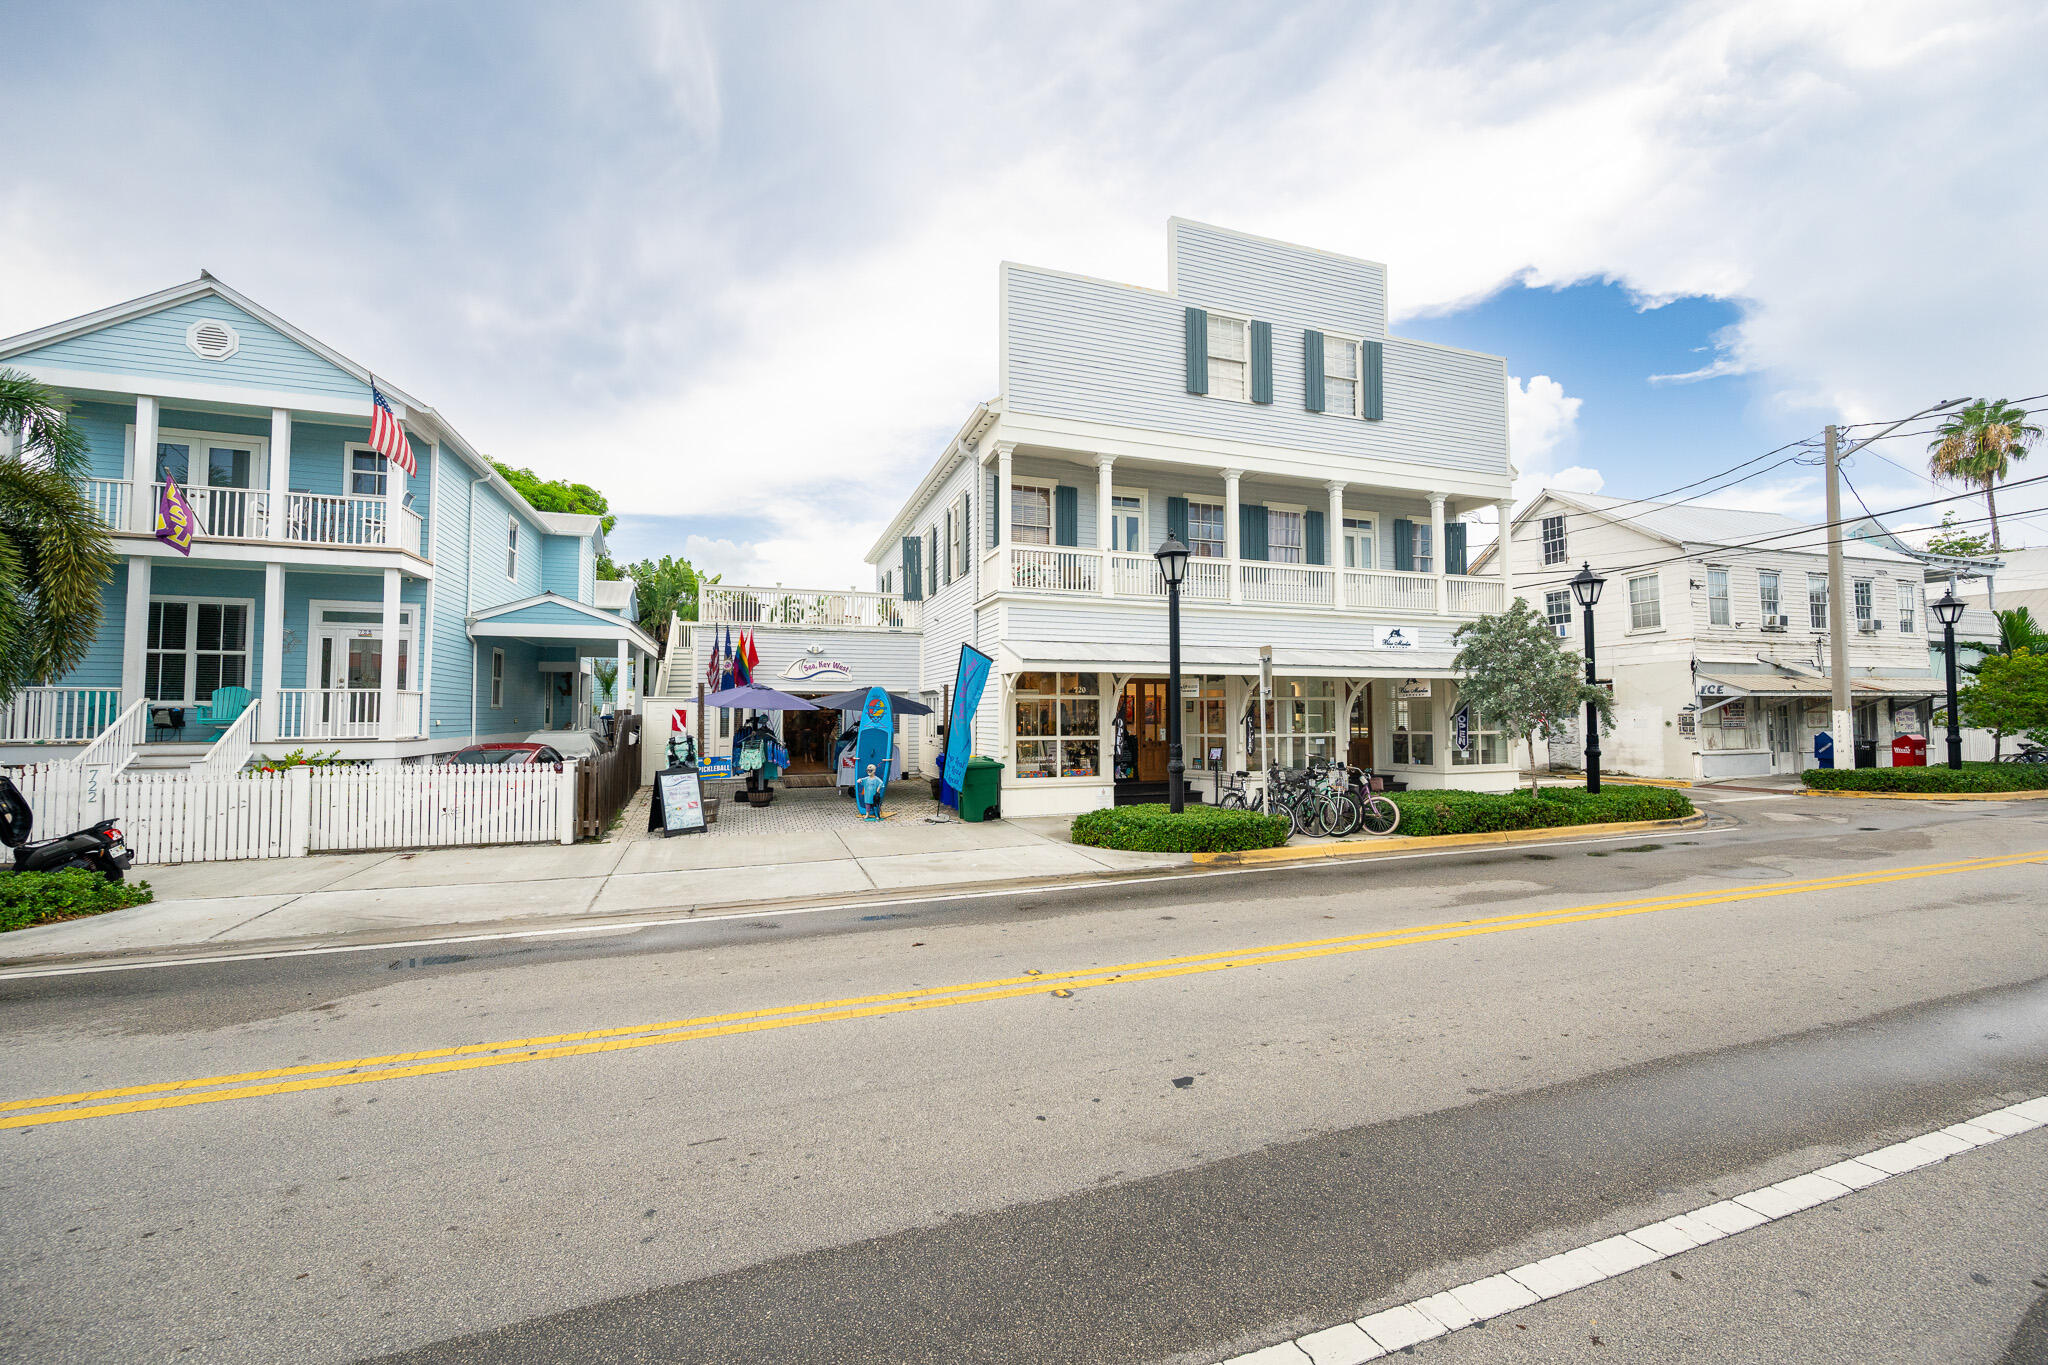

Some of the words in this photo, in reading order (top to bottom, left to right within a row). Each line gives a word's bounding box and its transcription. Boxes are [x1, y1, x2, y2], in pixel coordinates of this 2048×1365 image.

[818, 661, 831, 669] Key
[832, 661, 849, 673] West
[1700, 684, 1724, 695] ICE
[1458, 715, 1467, 746] OPEN
[698, 765, 730, 773] PICKLEBALL
[88, 769, 99, 803] 722
